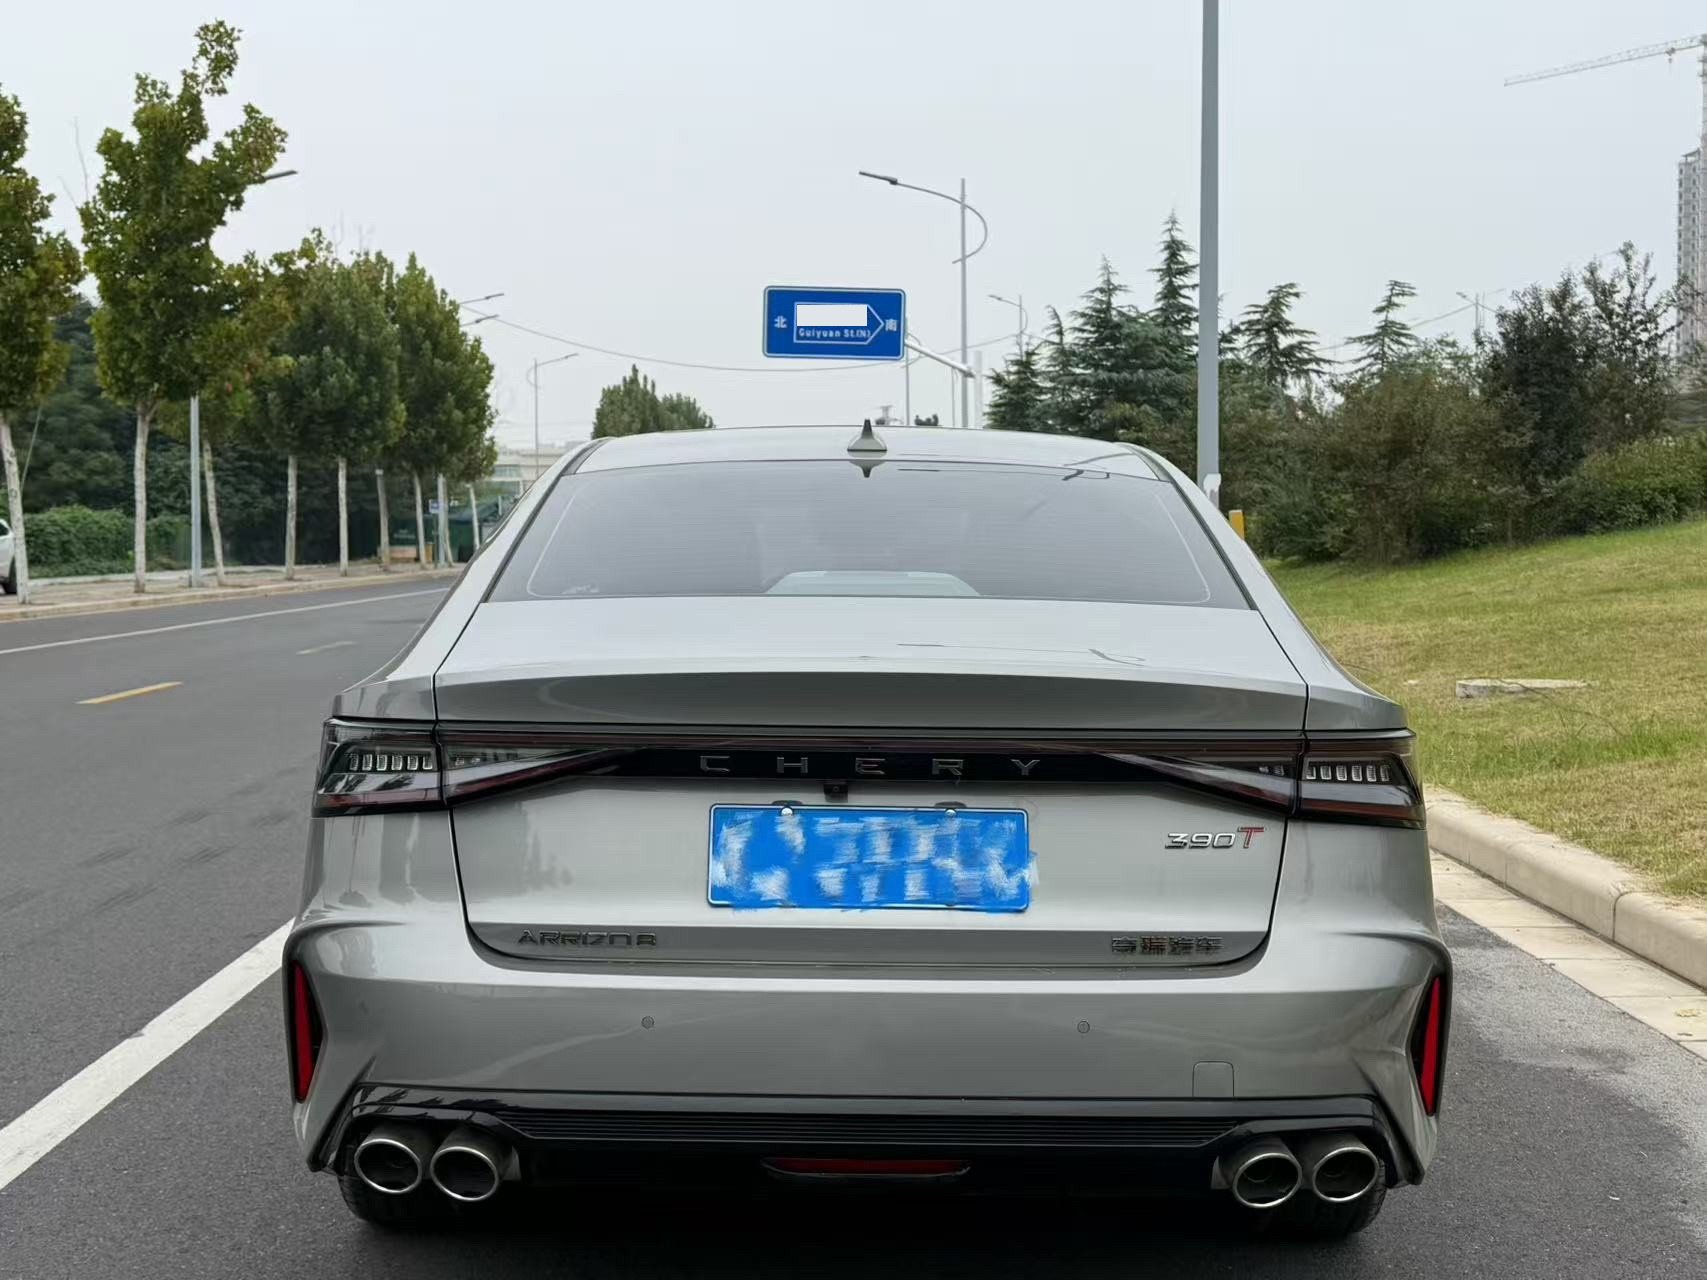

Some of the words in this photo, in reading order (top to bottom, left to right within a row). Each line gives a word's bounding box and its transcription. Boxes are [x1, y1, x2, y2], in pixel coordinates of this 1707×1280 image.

[774, 315, 788, 329] 北
[884, 318, 898, 332] 南
[798, 327, 841, 339] Guiyuan
[699, 754, 1041, 777] CHERY
[1164, 826, 1265, 850] 390T
